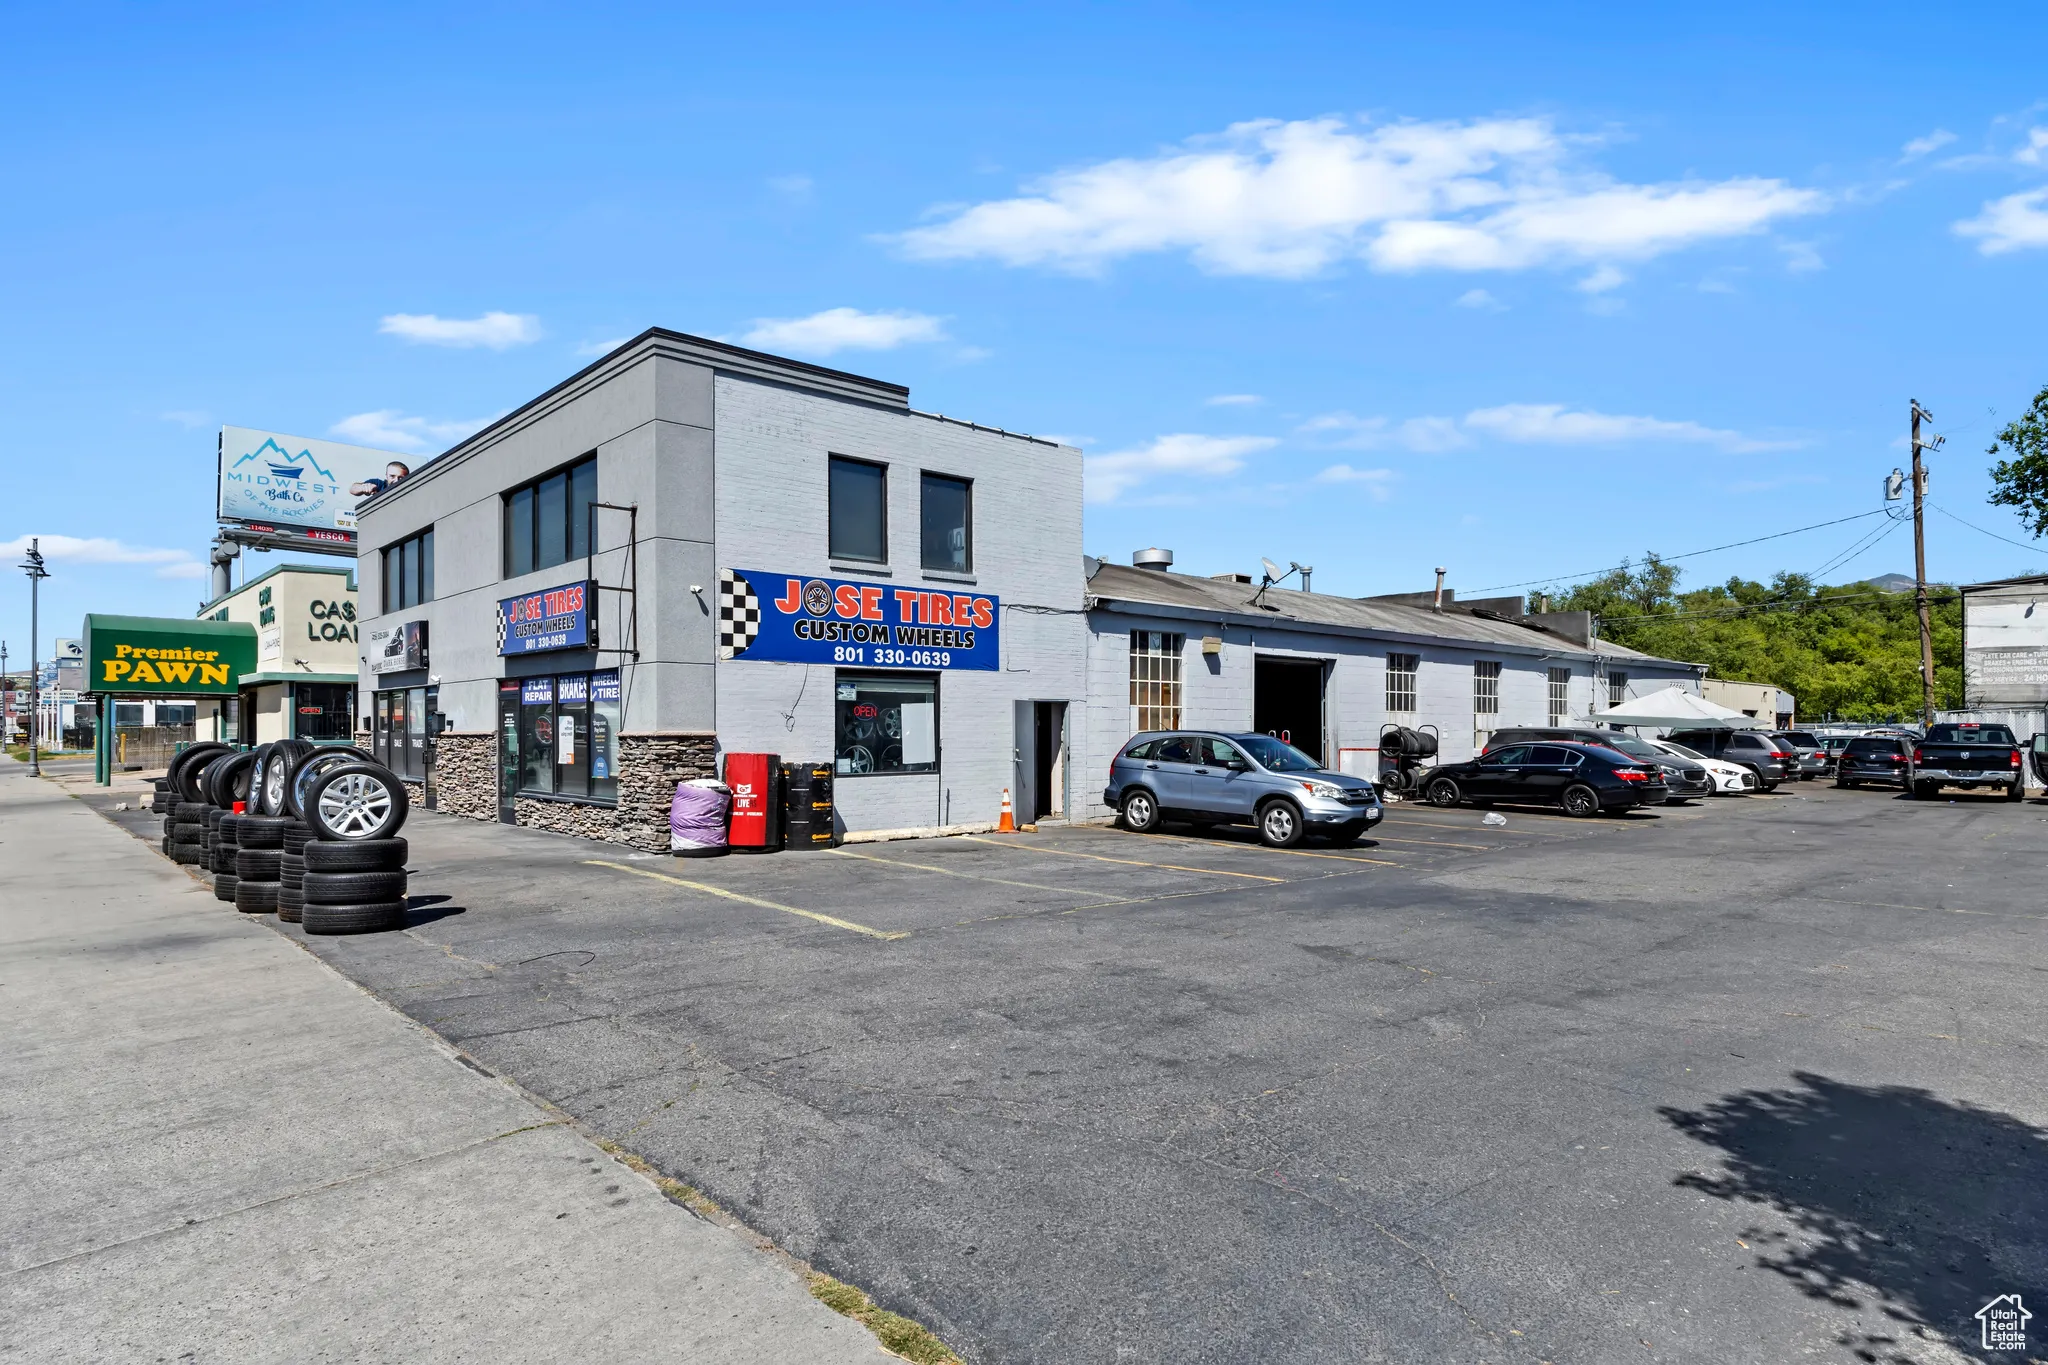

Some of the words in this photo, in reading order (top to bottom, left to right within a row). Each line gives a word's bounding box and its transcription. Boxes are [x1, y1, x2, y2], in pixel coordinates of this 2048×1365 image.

[227, 471, 340, 495] MIDWEST
[244, 489, 259, 501] OF
[258, 501, 279, 515] THE
[282, 498, 325, 516] ROCKIES
[265, 488, 291, 501] Bath
[310, 600, 358, 623] CA$
[509, 595, 542, 624] JOSE
[544, 585, 584, 616] TIRES
[774, 579, 884, 621] JOSE
[894, 589, 993, 629] TIRES
[515, 620, 544, 638] CUSTOM
[545, 615, 576, 633] WHEELS
[793, 619, 890, 645] CUSTOM
[895, 625, 975, 650] WHEELS
[525, 639, 536, 650] 801
[538, 633, 567, 648] 330-0639
[115, 644, 219, 662] Premier
[833, 646, 864, 663] 801
[873, 648, 951, 667] 330-0639
[2012, 651, 2027, 659] CARE
[102, 660, 231, 685] PAWN
[528, 680, 548, 690] FLAT
[524, 691, 552, 702] REPAIR
[299, 707, 321, 715] OPEN
[853, 705, 877, 717] OPEN
[394, 739, 402, 747] SALE
